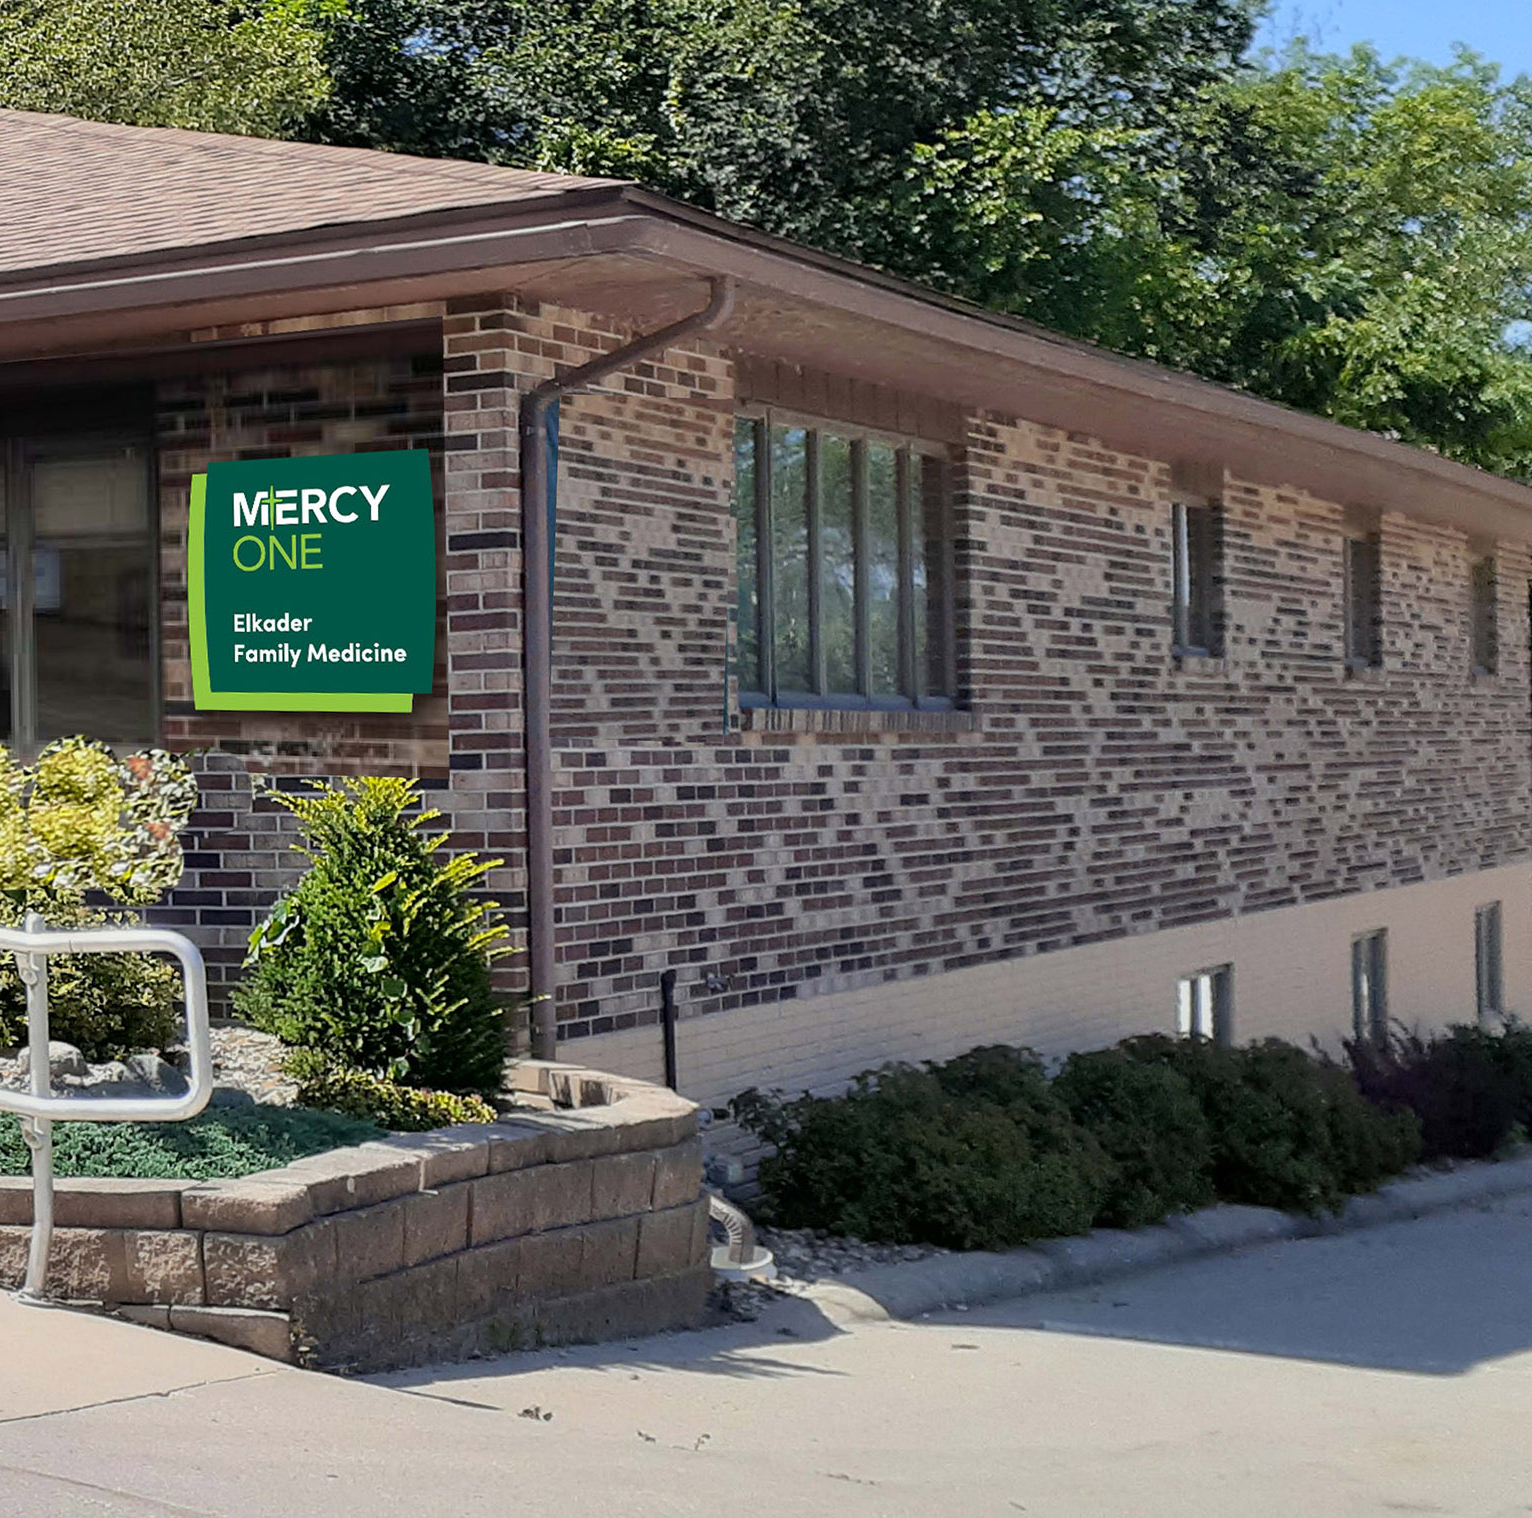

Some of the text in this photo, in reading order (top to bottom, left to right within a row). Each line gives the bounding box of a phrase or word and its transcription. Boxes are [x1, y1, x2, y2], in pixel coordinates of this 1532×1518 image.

[233, 484, 390, 529] MERCY
[233, 534, 323, 572] ONE
[233, 612, 313, 633] Elkader
[234, 642, 407, 668] Family Medicine
